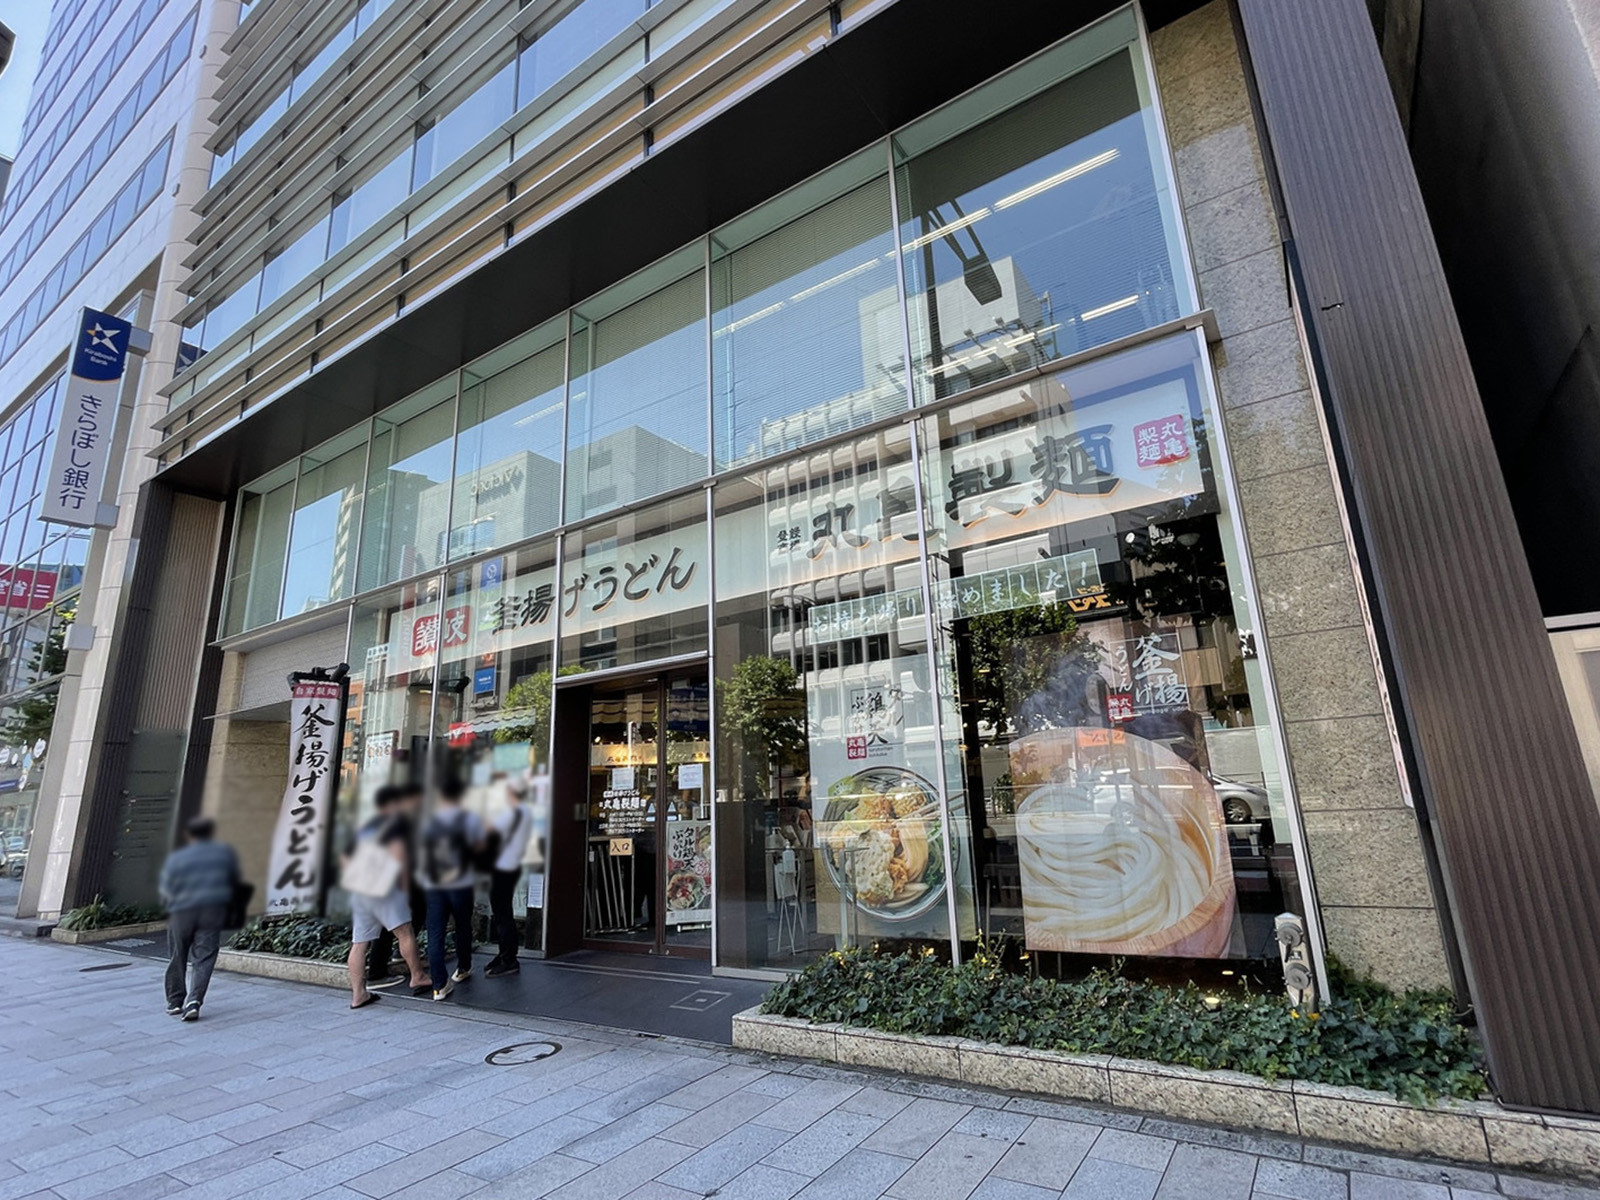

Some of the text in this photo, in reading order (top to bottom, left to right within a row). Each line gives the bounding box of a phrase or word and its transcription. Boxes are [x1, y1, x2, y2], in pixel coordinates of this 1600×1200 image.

[60, 394, 102, 509] きらぼし銀行
[492, 546, 696, 635] 釜揚げうどん
[274, 703, 335, 890] 釜揚げうどん
[611, 841, 630, 853] 入口
